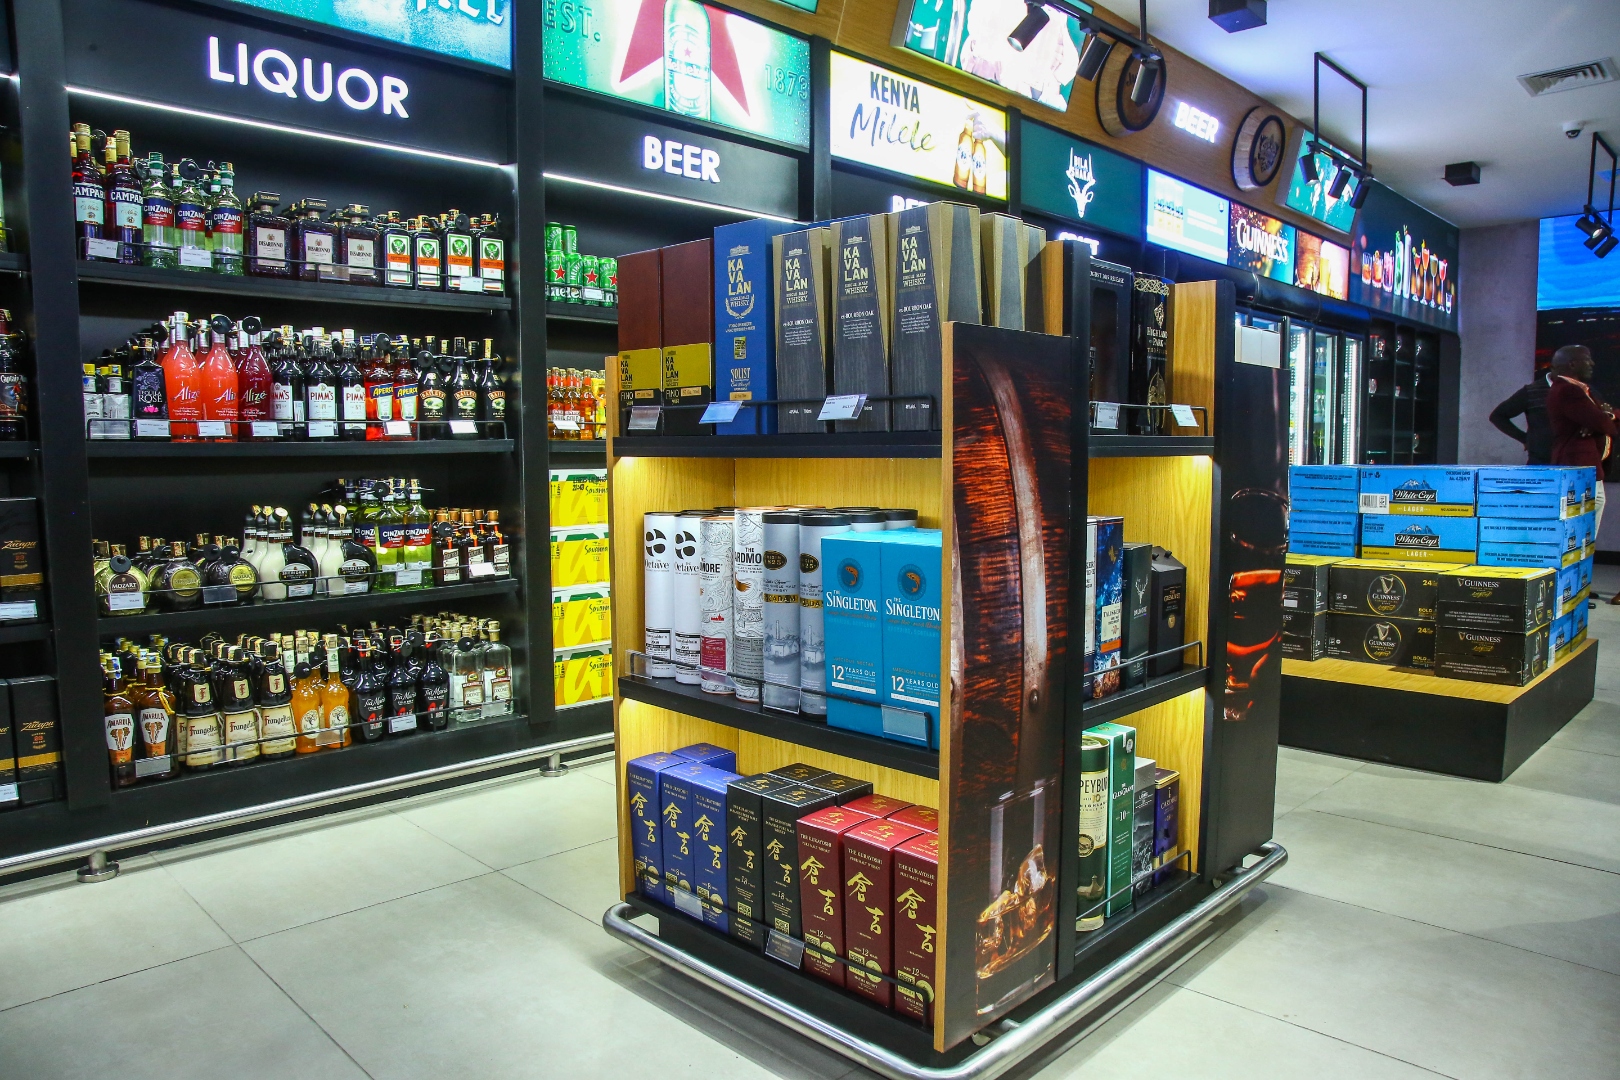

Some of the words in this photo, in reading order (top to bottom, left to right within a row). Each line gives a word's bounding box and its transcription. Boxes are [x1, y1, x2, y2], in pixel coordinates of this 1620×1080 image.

[208, 36, 410, 118] LIQUOR
[765, 63, 809, 101] 1873
[870, 71, 920, 114] KENYA
[850, 103, 935, 152] Milele
[1173, 101, 1220, 144] BEER
[643, 135, 721, 184] BEER
[143, 204, 173, 215] CINZANO
[177, 209, 206, 220] CINZANO
[213, 212, 241, 223] CINZANO
[901, 237, 917, 249] KA
[1237, 218, 1289, 264] GUINNESS
[844, 246, 860, 258] KA
[902, 249, 917, 261] VA
[728, 258, 744, 271] KA
[785, 258, 801, 269] KA
[844, 257, 860, 269] VA
[902, 259, 926, 273] LAN
[729, 271, 744, 284] VA
[786, 268, 801, 280] VA
[844, 268, 868, 281] LAN
[786, 278, 808, 291] LAN
[903, 277, 926, 288] WHISKY
[729, 281, 752, 296] LAN
[845, 286, 868, 295] WHISKY
[786, 295, 808, 304] WHISKY
[665, 356, 674, 364] KA
[620, 374, 633, 382] LAN
[665, 371, 679, 379] LAN
[138, 393, 163, 404] ROSE
[241, 387, 267, 403] Alizé
[311, 391, 335, 401] PIMM'S
[1394, 490, 1418, 500] White
[1419, 490, 1437, 502] Cap
[405, 527, 430, 536] CINZANO
[1396, 535, 1420, 545] White
[1420, 535, 1438, 547] Cap
[1406, 550, 1428, 558] LAGER
[112, 581, 137, 590] MOZART
[1422, 579, 1432, 587] 24
[1464, 580, 1500, 588] GUINNESS
[1372, 593, 1401, 601] GUINNESS
[1368, 640, 1397, 648] GUINNESS
[1465, 634, 1502, 643] GUINNESS
[832, 664, 844, 681] 12
[845, 667, 863, 676] YEARS
[864, 669, 877, 677] OLD
[891, 676, 905, 693] 12
[905, 678, 925, 688] YEARS
[926, 681, 939, 690] OLD
[142, 712, 166, 721] AMARULA
[107, 717, 132, 729] AMARULA
[1092, 792, 1101, 803] 10
[1119, 810, 1127, 822] 10
[816, 929, 825, 938] 12
[862, 947, 870, 957] 12
[911, 967, 920, 977] 12
